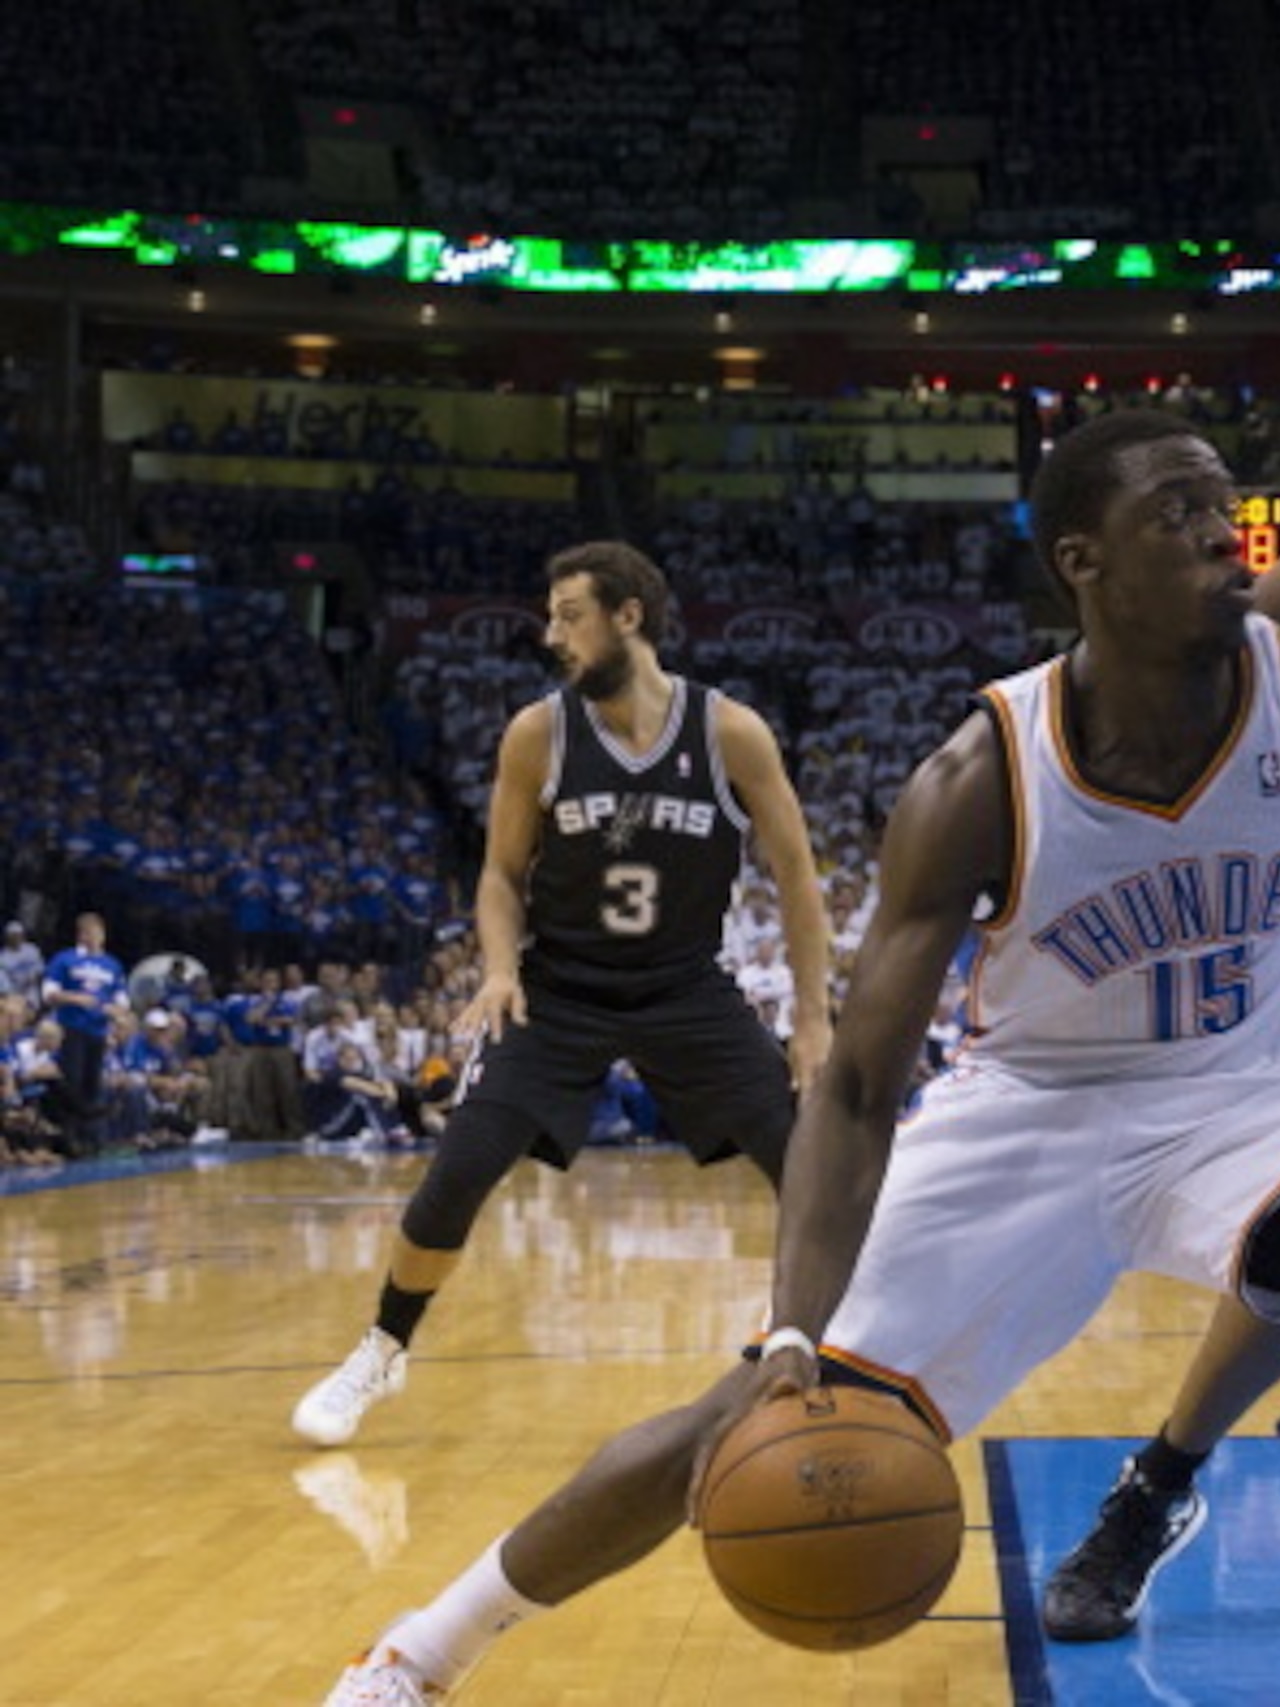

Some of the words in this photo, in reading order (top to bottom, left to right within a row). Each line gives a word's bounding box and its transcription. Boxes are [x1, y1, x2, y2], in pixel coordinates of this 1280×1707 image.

[554, 791, 718, 848] SPURS
[599, 863, 661, 937] 3
[1134, 943, 1256, 1043] 15
